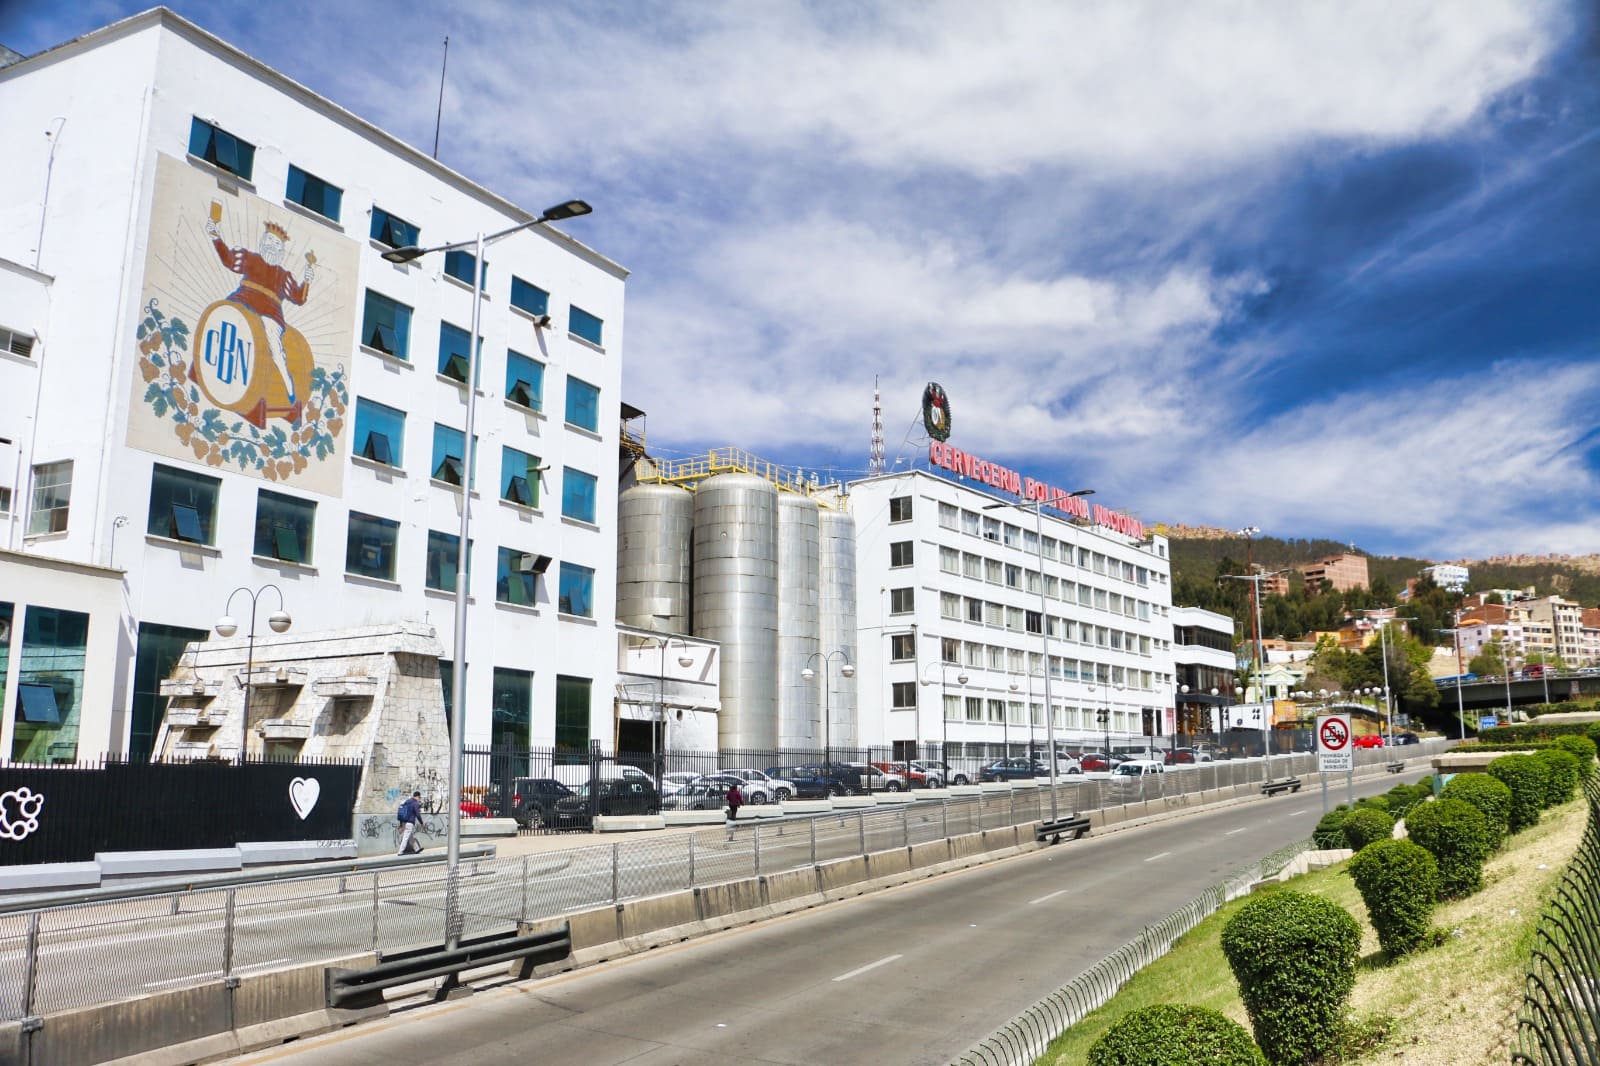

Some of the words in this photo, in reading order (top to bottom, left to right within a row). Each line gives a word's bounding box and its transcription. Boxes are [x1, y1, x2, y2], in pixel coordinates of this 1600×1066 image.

[205, 321, 251, 386] CBN
[930, 440, 1021, 496] CERVECERIA
[1093, 503, 1146, 541] NACIONAL
